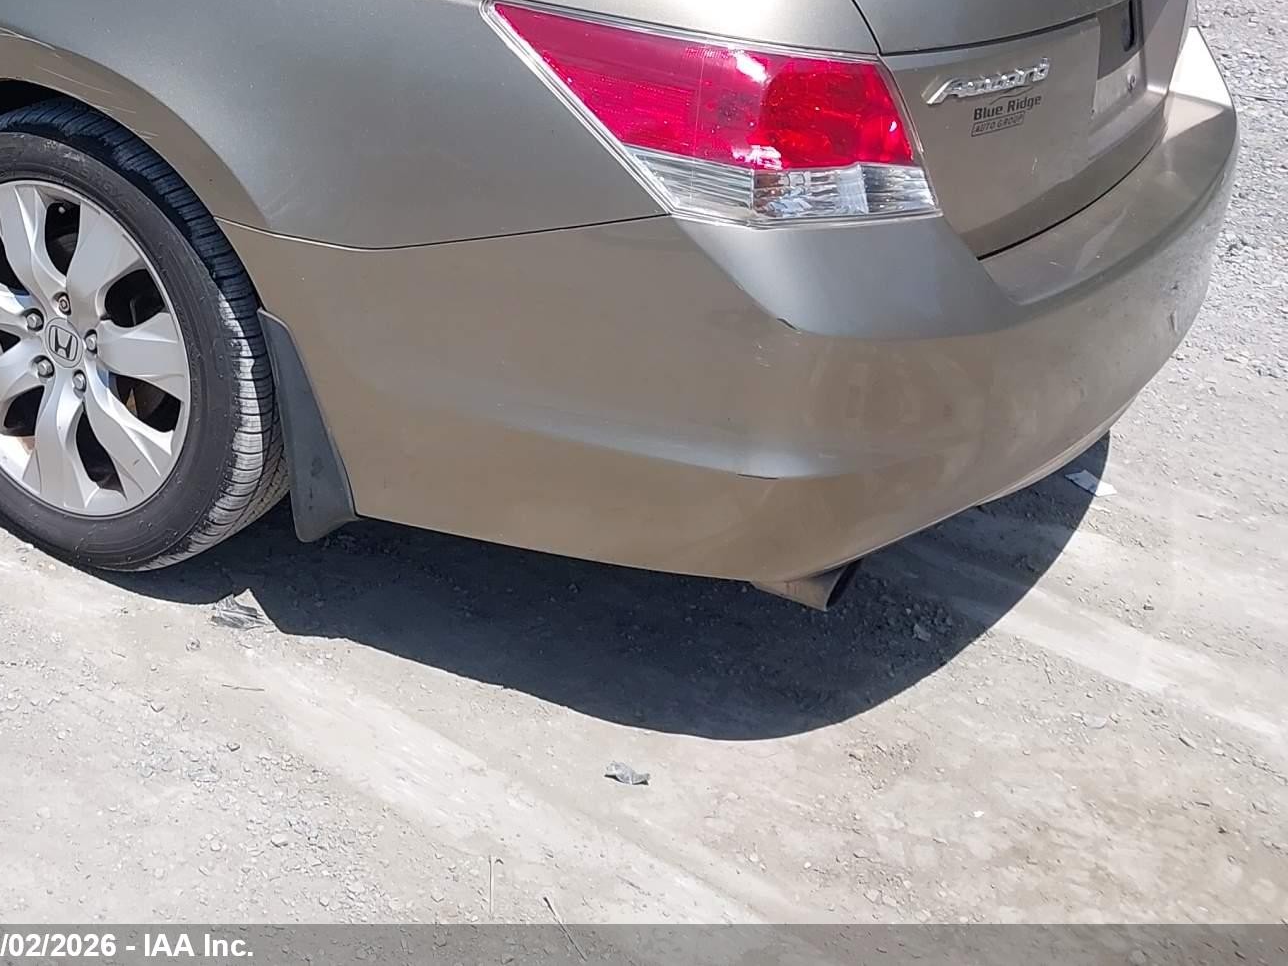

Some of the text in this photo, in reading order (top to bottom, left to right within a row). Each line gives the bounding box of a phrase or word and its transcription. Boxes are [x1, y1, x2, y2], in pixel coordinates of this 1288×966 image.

[973, 95, 1042, 121] Blue Ridge
[974, 113, 1024, 133] AUTO GROUP
